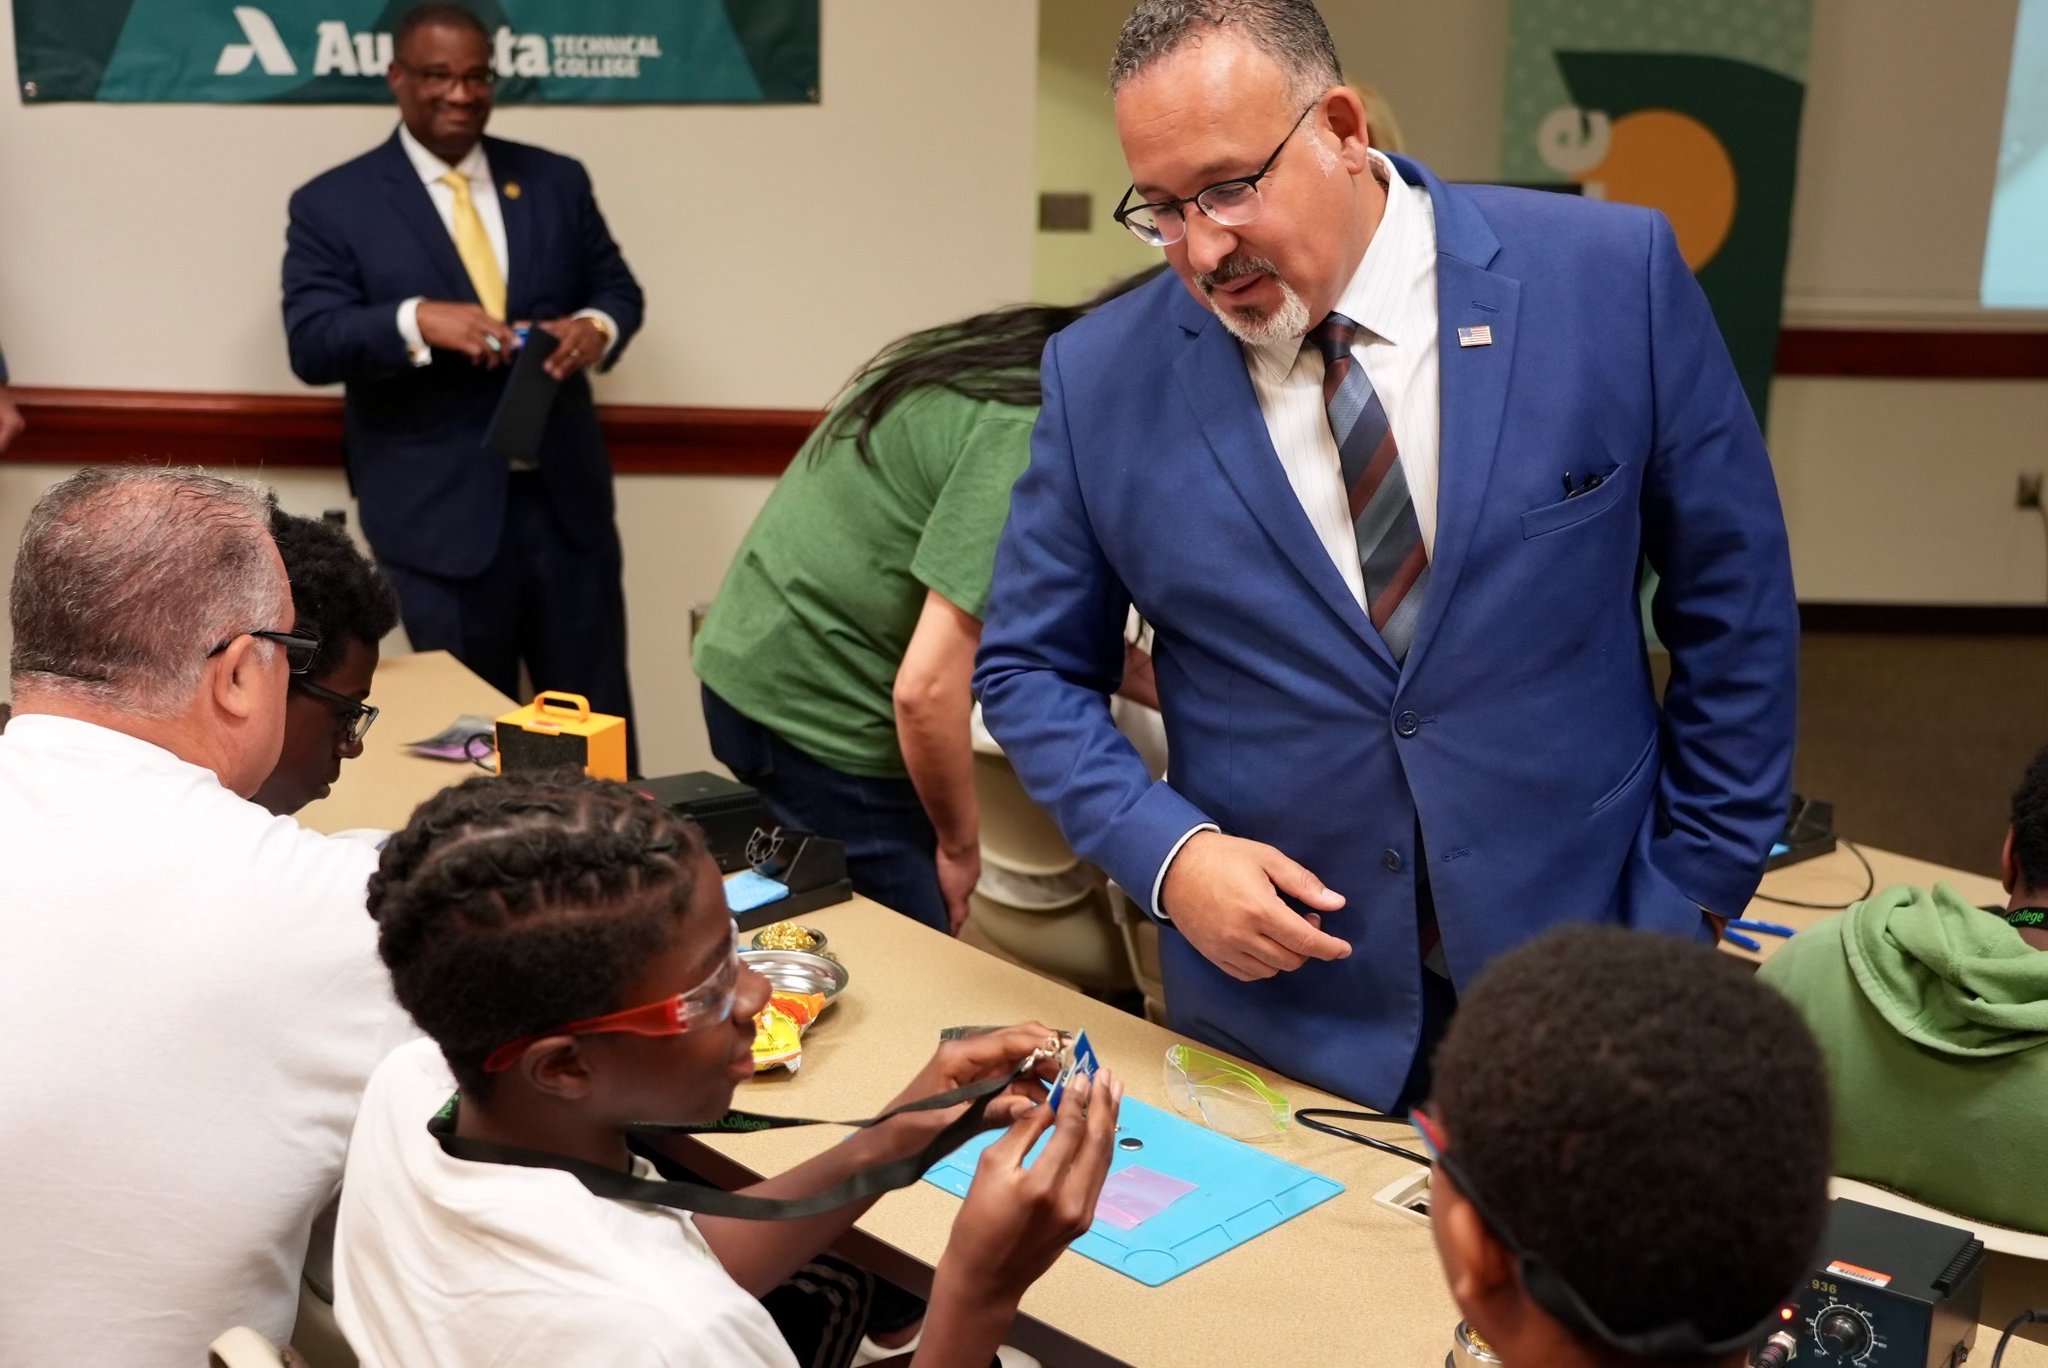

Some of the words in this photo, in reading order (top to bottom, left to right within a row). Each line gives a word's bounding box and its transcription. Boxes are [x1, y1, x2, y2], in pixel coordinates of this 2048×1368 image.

[313, 19, 551, 77] Auta
[552, 35, 661, 57] TECHNICAL
[553, 57, 640, 77] COLLEGE
[2011, 909, 2044, 924] College
[720, 1114, 771, 1130] College
[1811, 1279, 1837, 1294] 936
